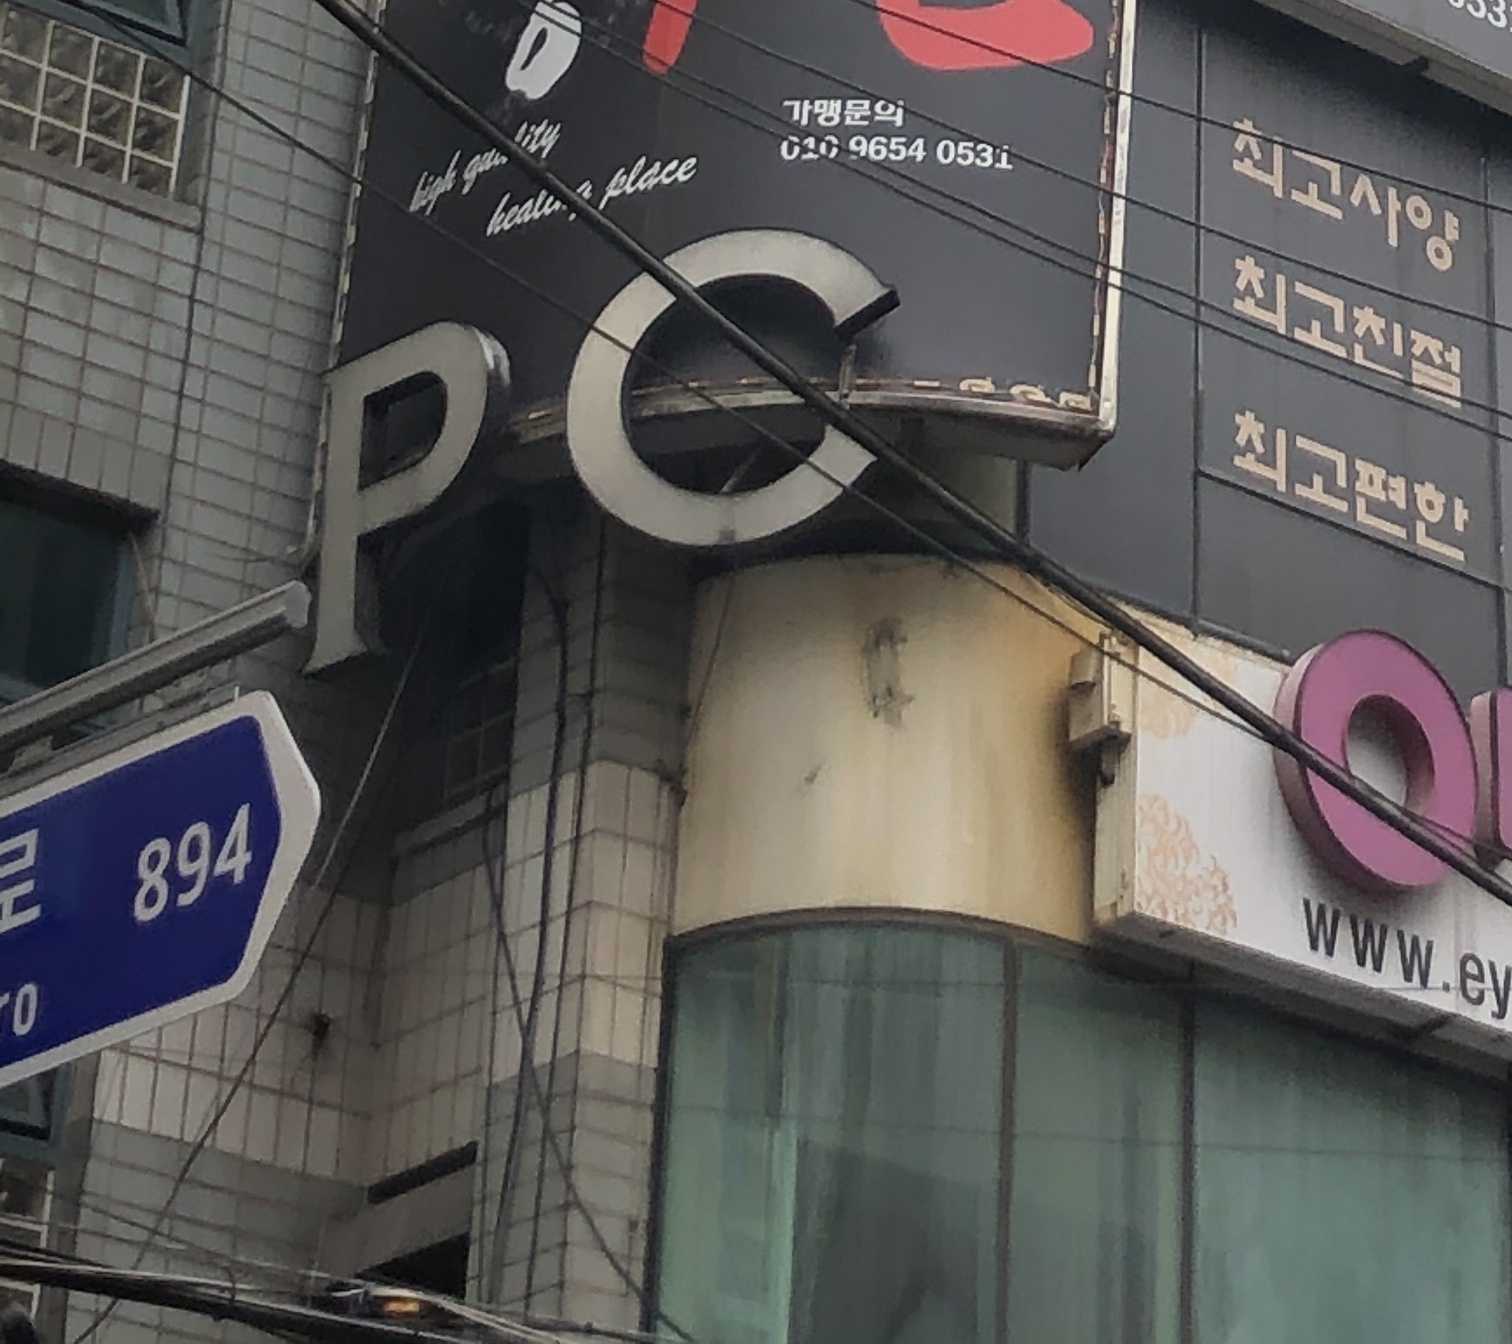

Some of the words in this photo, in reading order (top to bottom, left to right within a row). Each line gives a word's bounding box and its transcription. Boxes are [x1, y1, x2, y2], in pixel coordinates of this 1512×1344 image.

[780, 134, 840, 161] 010
[848, 134, 928, 163] 9654
[936, 139, 1014, 171] 0531
[782, 99, 906, 127] 가맹문의
[409, 150, 462, 216] high
[598, 155, 699, 211] place
[1232, 116, 1461, 273] 최고사양
[1233, 254, 1463, 409] 최고친절
[302, 226, 901, 676] PC
[1233, 409, 1471, 563] 최고편한
[132, 803, 253, 924] 894
